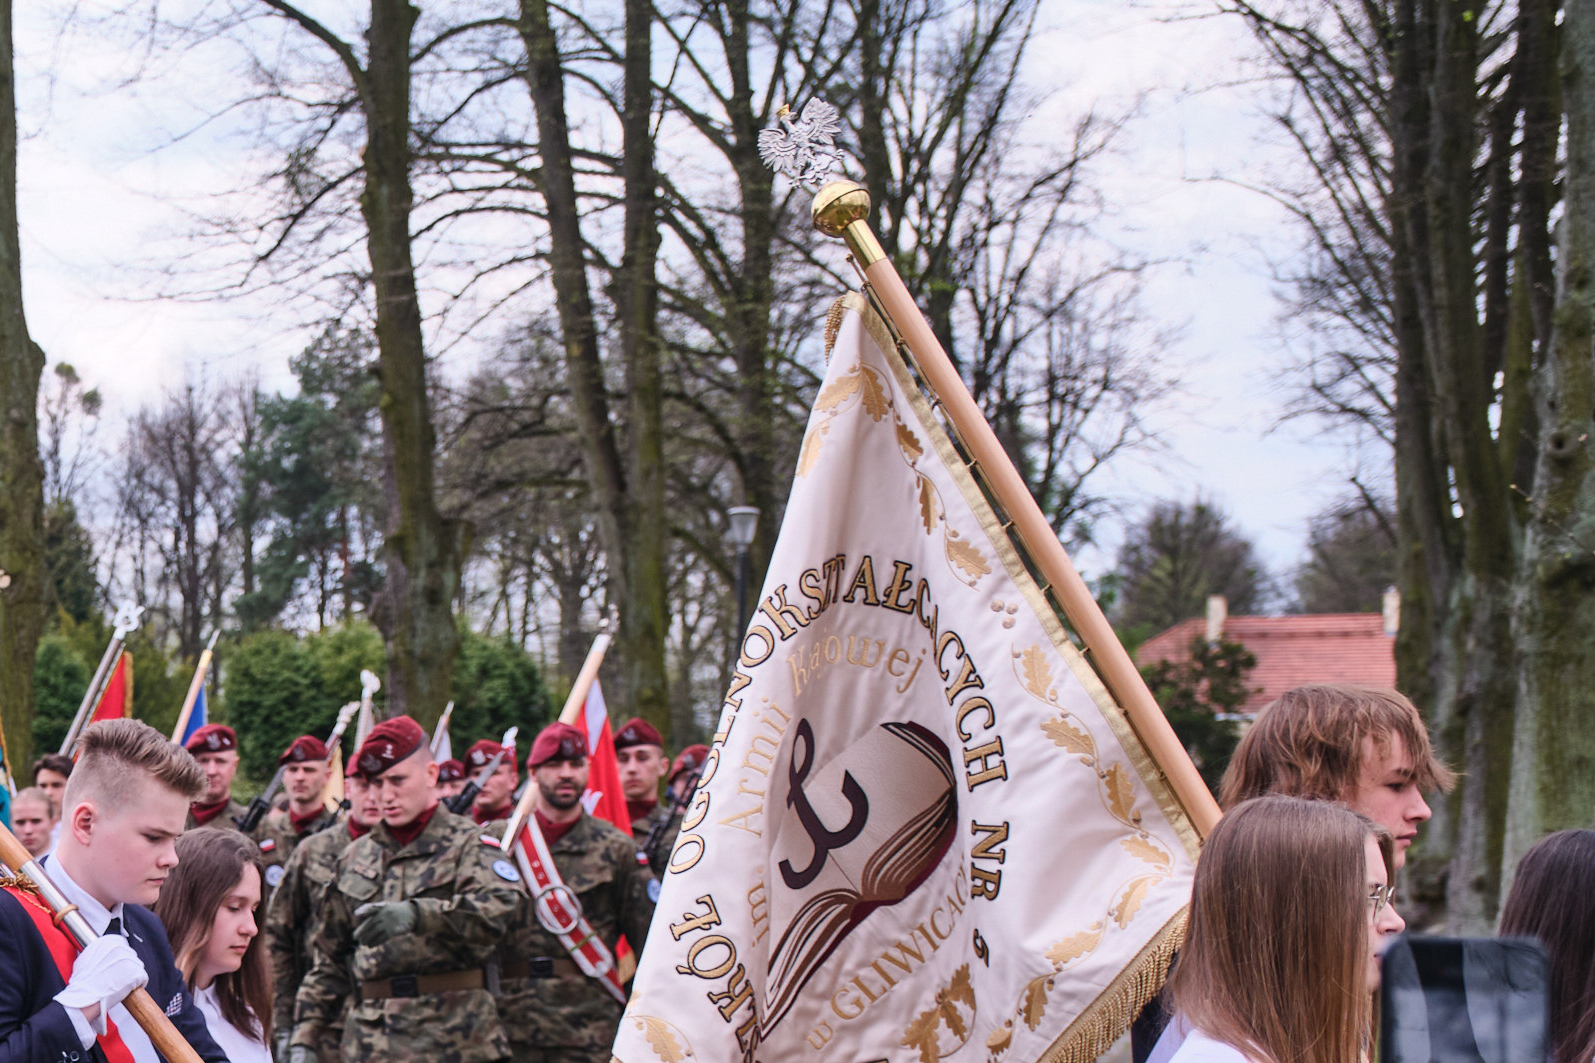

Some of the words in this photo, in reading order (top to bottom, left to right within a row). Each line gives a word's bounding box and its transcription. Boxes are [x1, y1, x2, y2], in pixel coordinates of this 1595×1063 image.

[717, 696, 792, 839] Armii
[971, 820, 1010, 901] NR
[973, 928, 990, 968] 5
[806, 1019, 834, 1051] w
